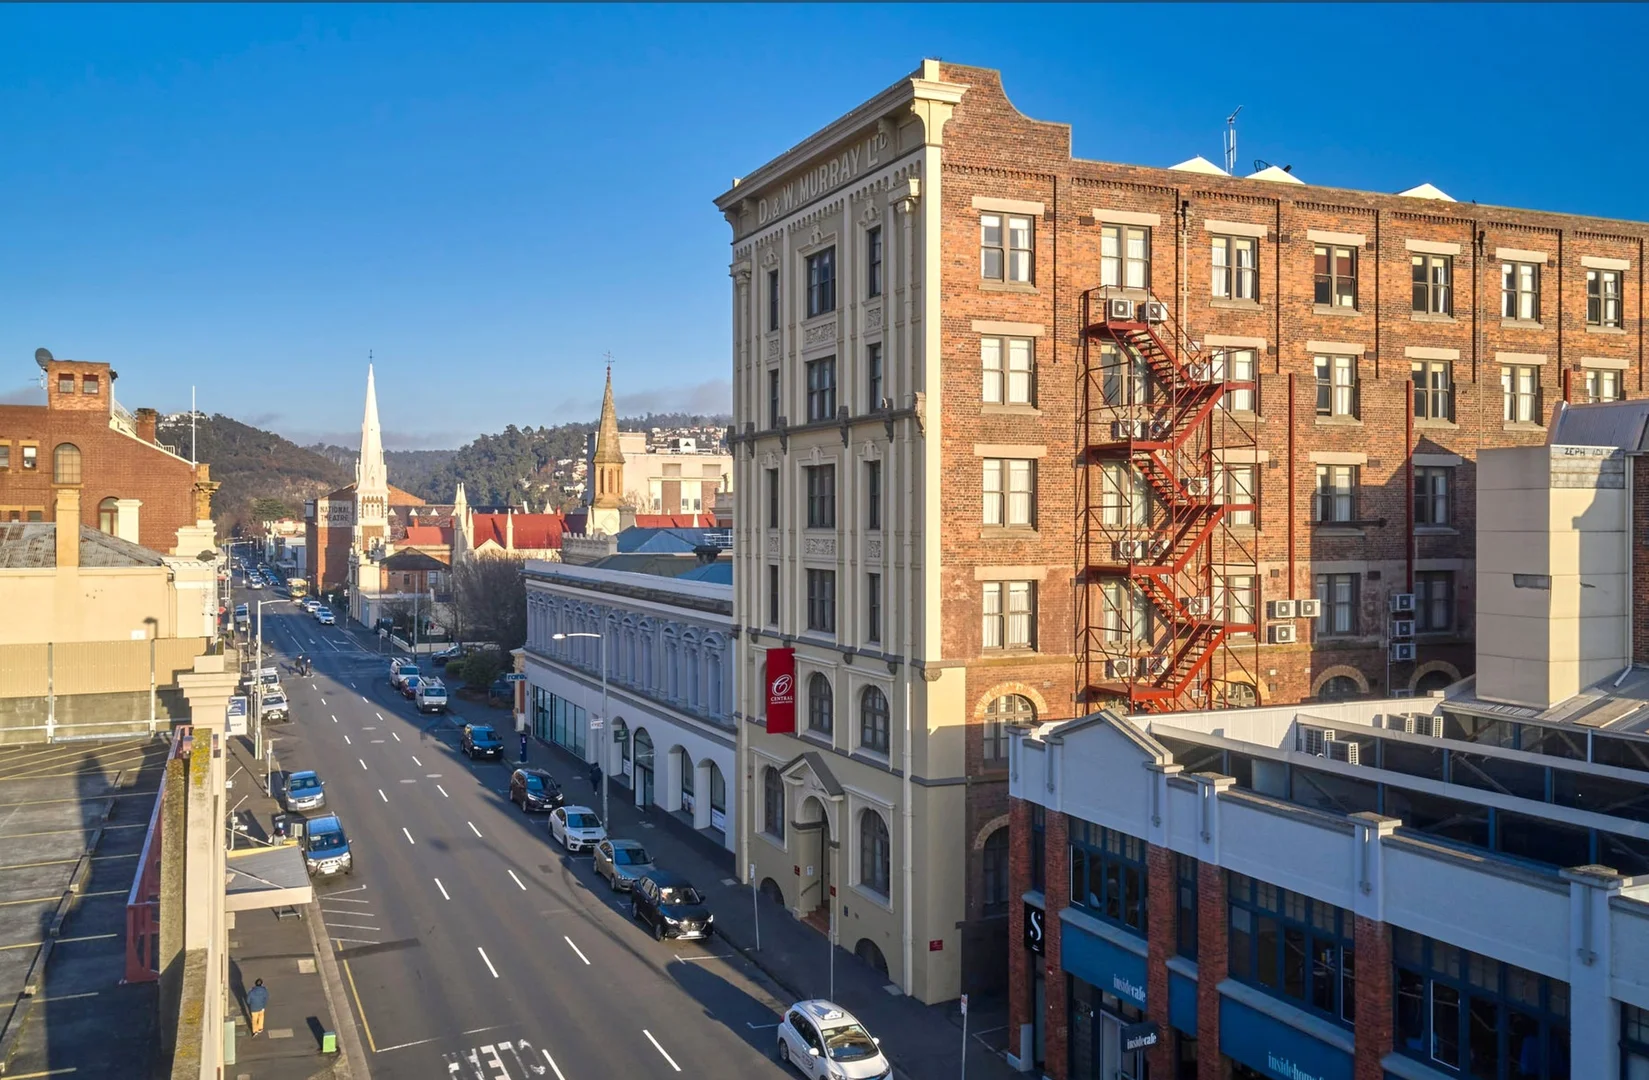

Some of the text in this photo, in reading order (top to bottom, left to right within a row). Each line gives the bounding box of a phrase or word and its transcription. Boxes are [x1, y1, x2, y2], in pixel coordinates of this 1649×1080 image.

[772, 197, 781, 218] &
[799, 143, 861, 203] MURRAY
[320, 506, 350, 514] NATIONAL
[321, 514, 349, 522] THEATRE
